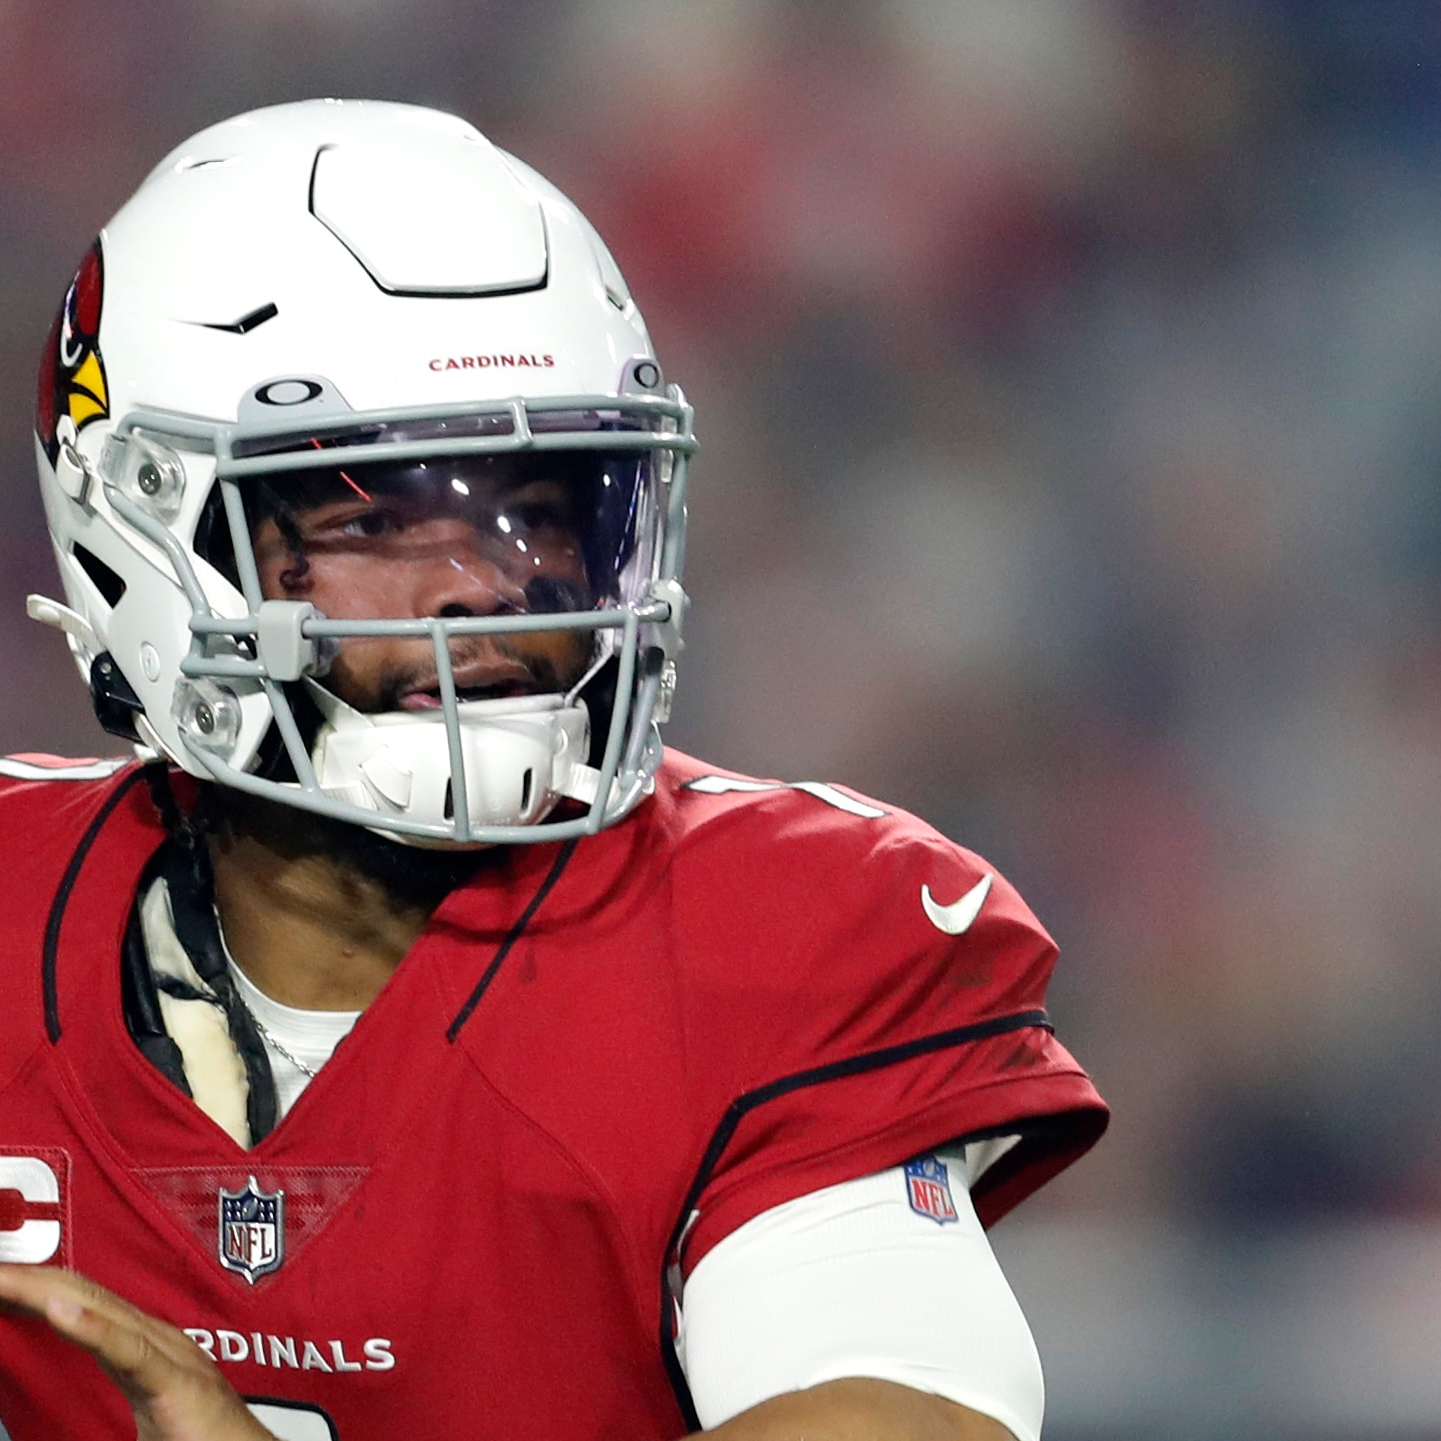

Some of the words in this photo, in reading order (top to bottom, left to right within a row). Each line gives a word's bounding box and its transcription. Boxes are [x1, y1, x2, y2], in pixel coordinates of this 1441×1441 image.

[429, 355, 554, 372] CARDINALS
[912, 1179, 953, 1217] NFL
[228, 1225, 273, 1264] NFL
[183, 1327, 396, 1373] RDINALS
